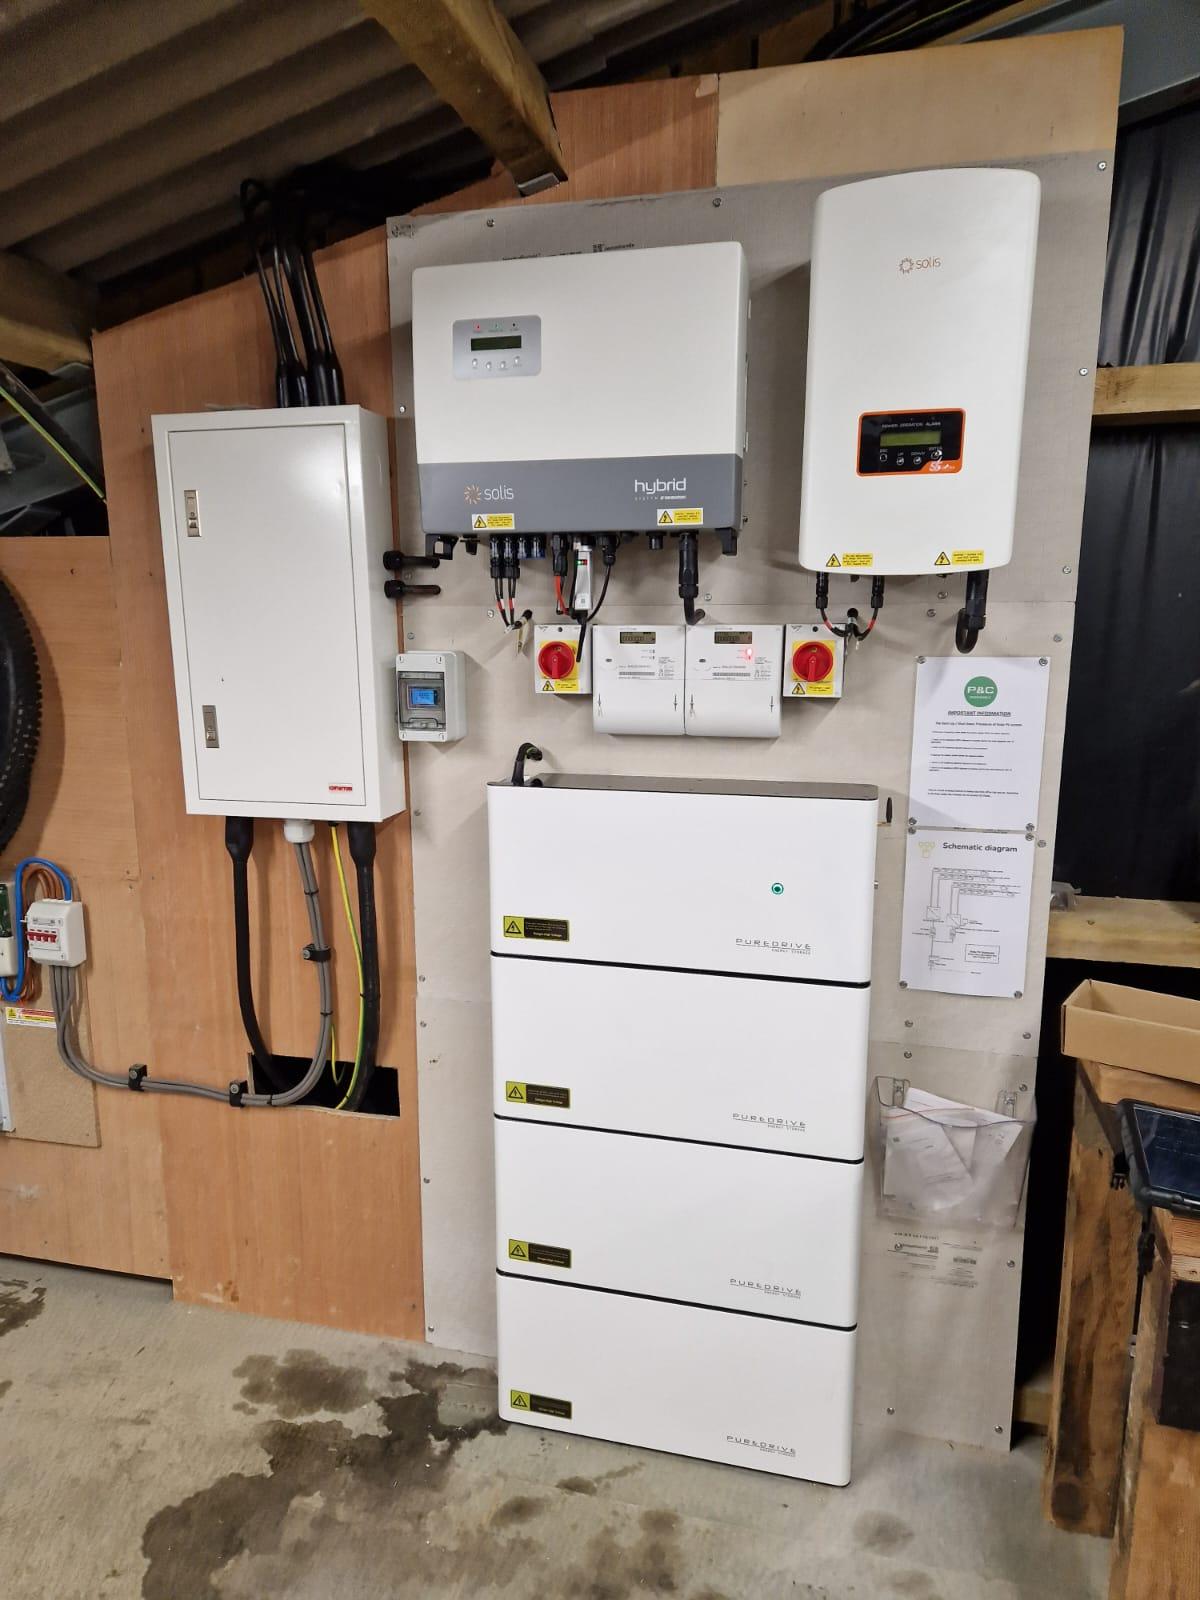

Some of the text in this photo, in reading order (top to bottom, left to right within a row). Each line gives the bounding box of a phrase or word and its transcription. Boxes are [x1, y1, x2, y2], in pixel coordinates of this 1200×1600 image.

[915, 256, 942, 270] solis
[483, 484, 514, 501] solis
[634, 477, 687, 494] hybrid
[967, 686, 995, 694] P&C
[942, 842, 1018, 853] Schematic diagram
[736, 938, 811, 950] PUREDRIVE
[732, 1112, 806, 1127] PUREDRIVE
